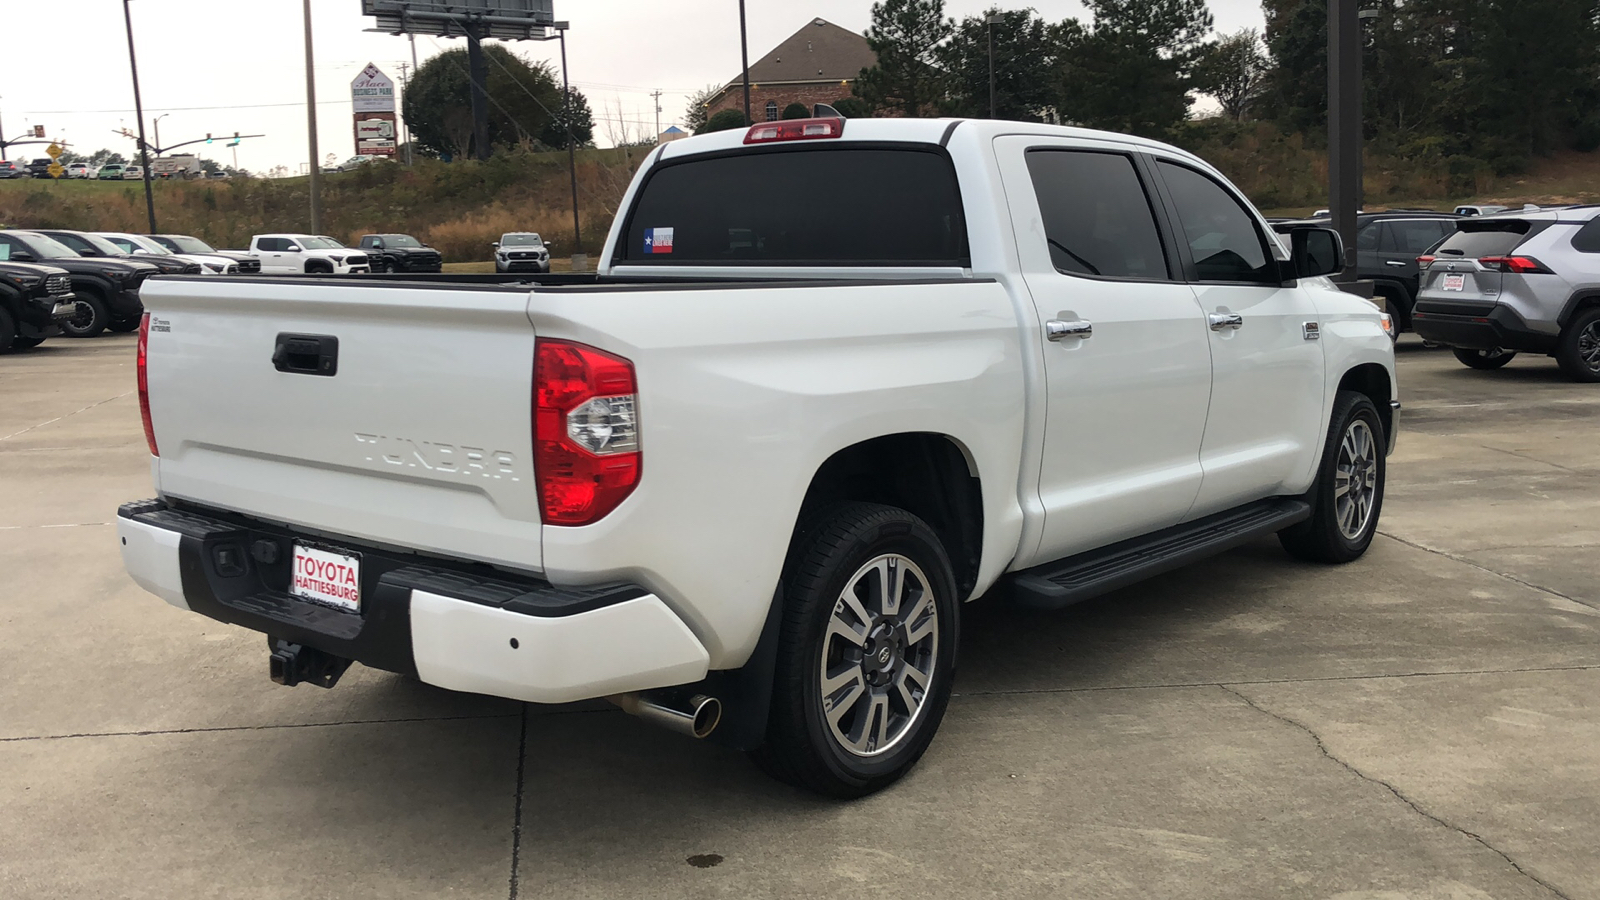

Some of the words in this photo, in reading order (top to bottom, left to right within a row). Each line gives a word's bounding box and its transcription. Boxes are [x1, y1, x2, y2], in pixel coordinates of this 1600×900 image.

[354, 433, 519, 480] TUNDRA
[296, 555, 356, 586] TOYOTA
[295, 575, 358, 601] HATTIESBURG
